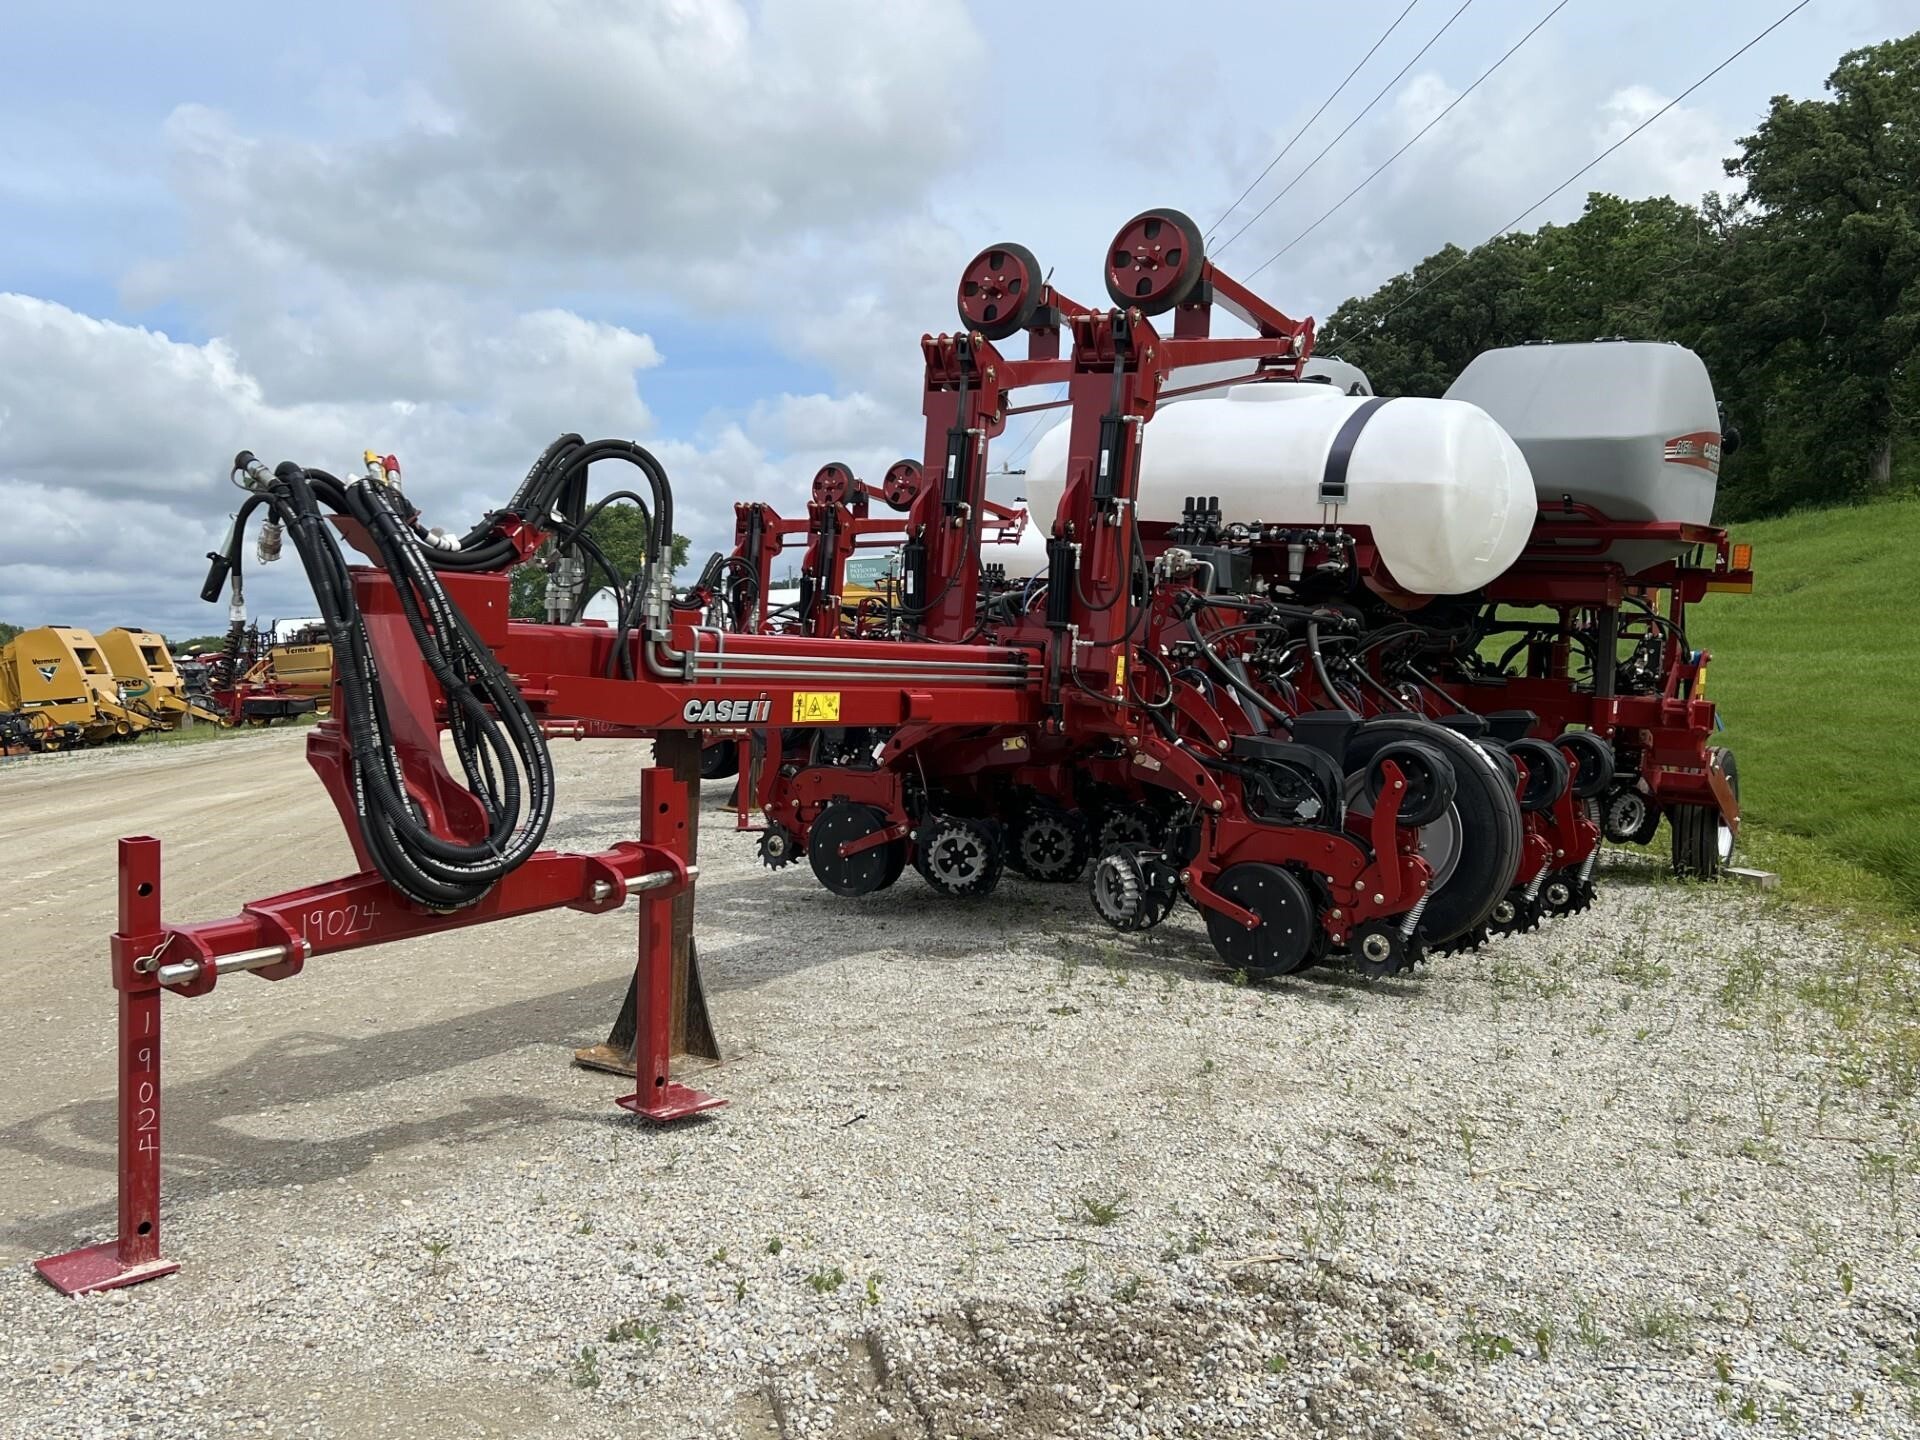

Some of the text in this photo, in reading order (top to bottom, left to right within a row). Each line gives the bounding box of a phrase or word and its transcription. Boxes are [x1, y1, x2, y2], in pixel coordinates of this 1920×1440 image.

[285, 646, 316, 655] Vermeer
[32, 657, 62, 666] Vermeer
[116, 678, 144, 688] meer
[683, 699, 750, 722] CASE
[303, 901, 381, 941] 19024
[137, 1011, 160, 1161] 19024
